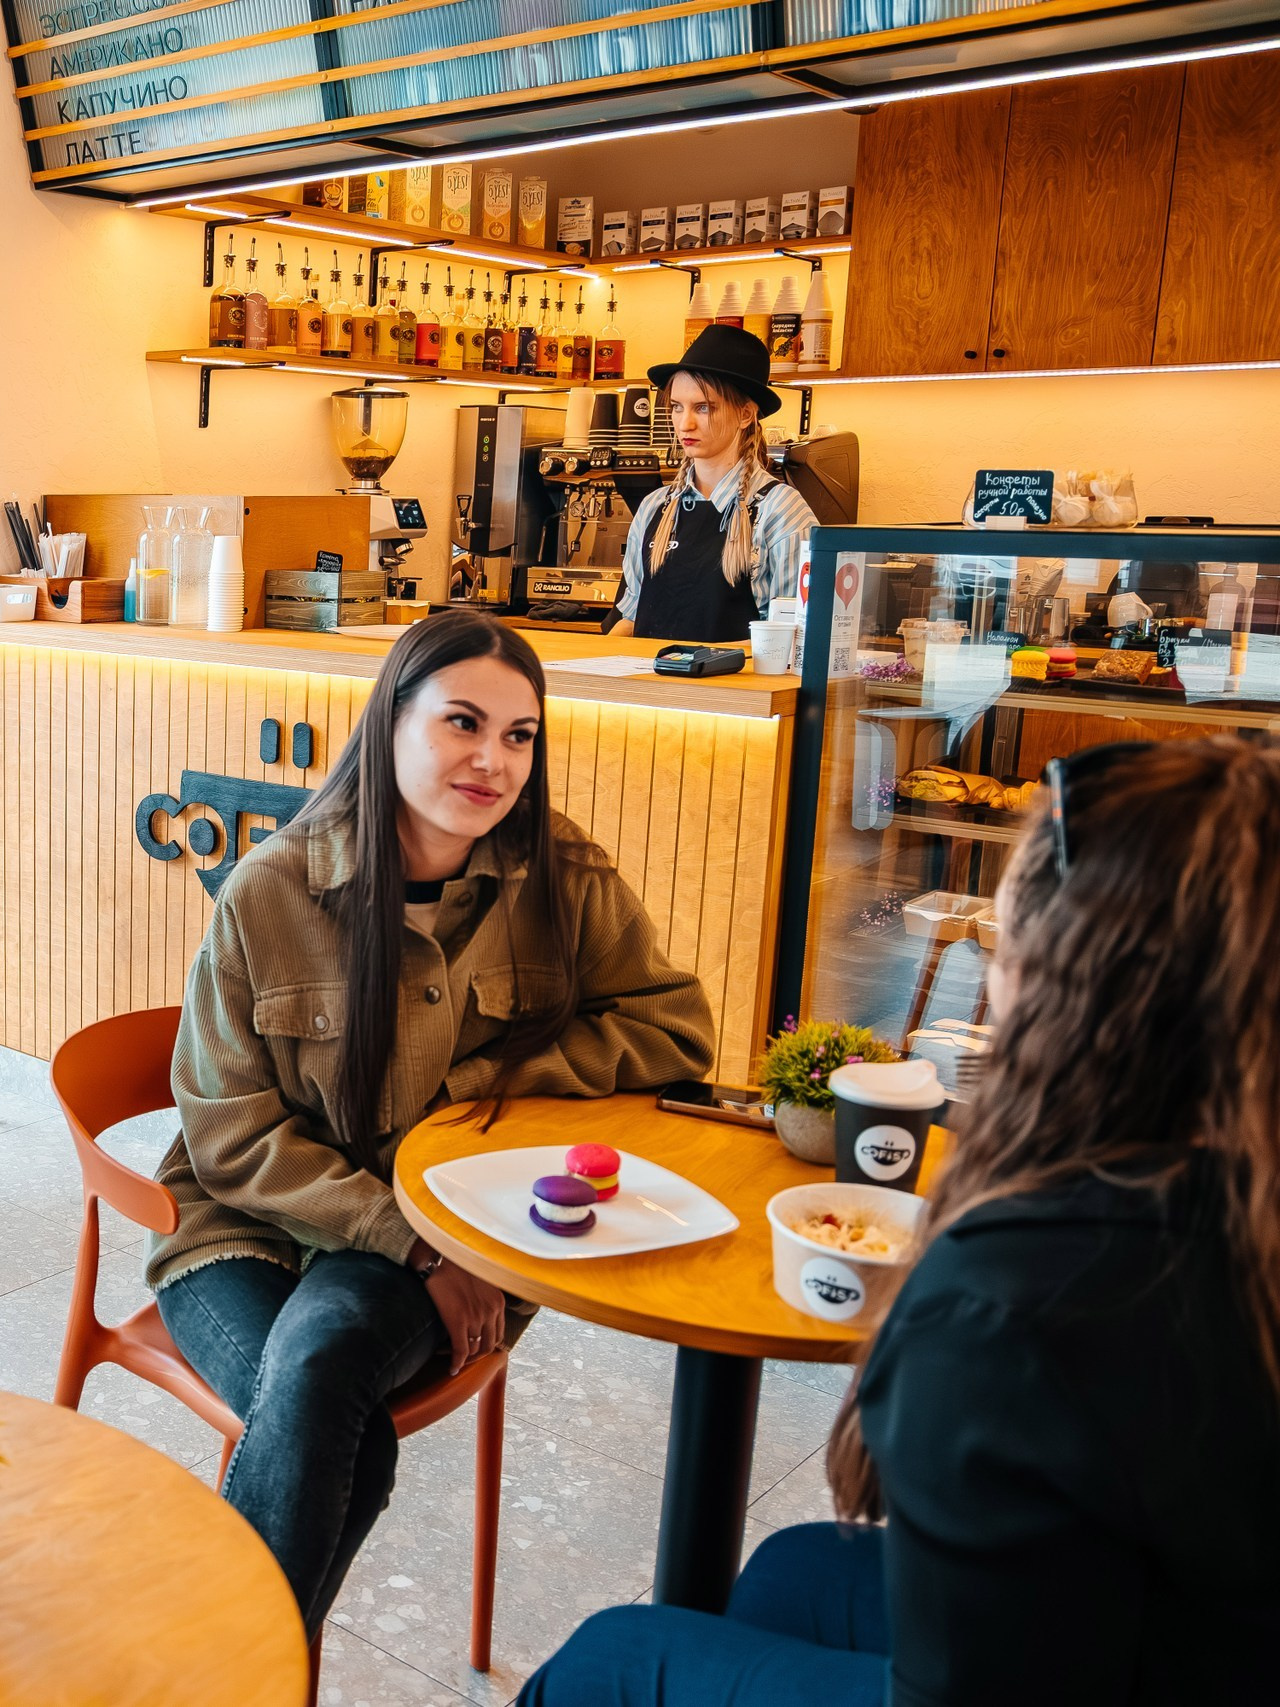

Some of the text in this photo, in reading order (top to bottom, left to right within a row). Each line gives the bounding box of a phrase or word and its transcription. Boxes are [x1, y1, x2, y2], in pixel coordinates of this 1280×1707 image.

[50, 27, 183, 80] АМЕРИКАНО
[57, 75, 188, 124] КАПУЧИНО
[65, 129, 144, 167] ЛАТТЕ
[978, 484, 1048, 499] ручной работы
[985, 472, 1040, 489] Конфеты
[542, 584, 570, 592] RANCILIO
